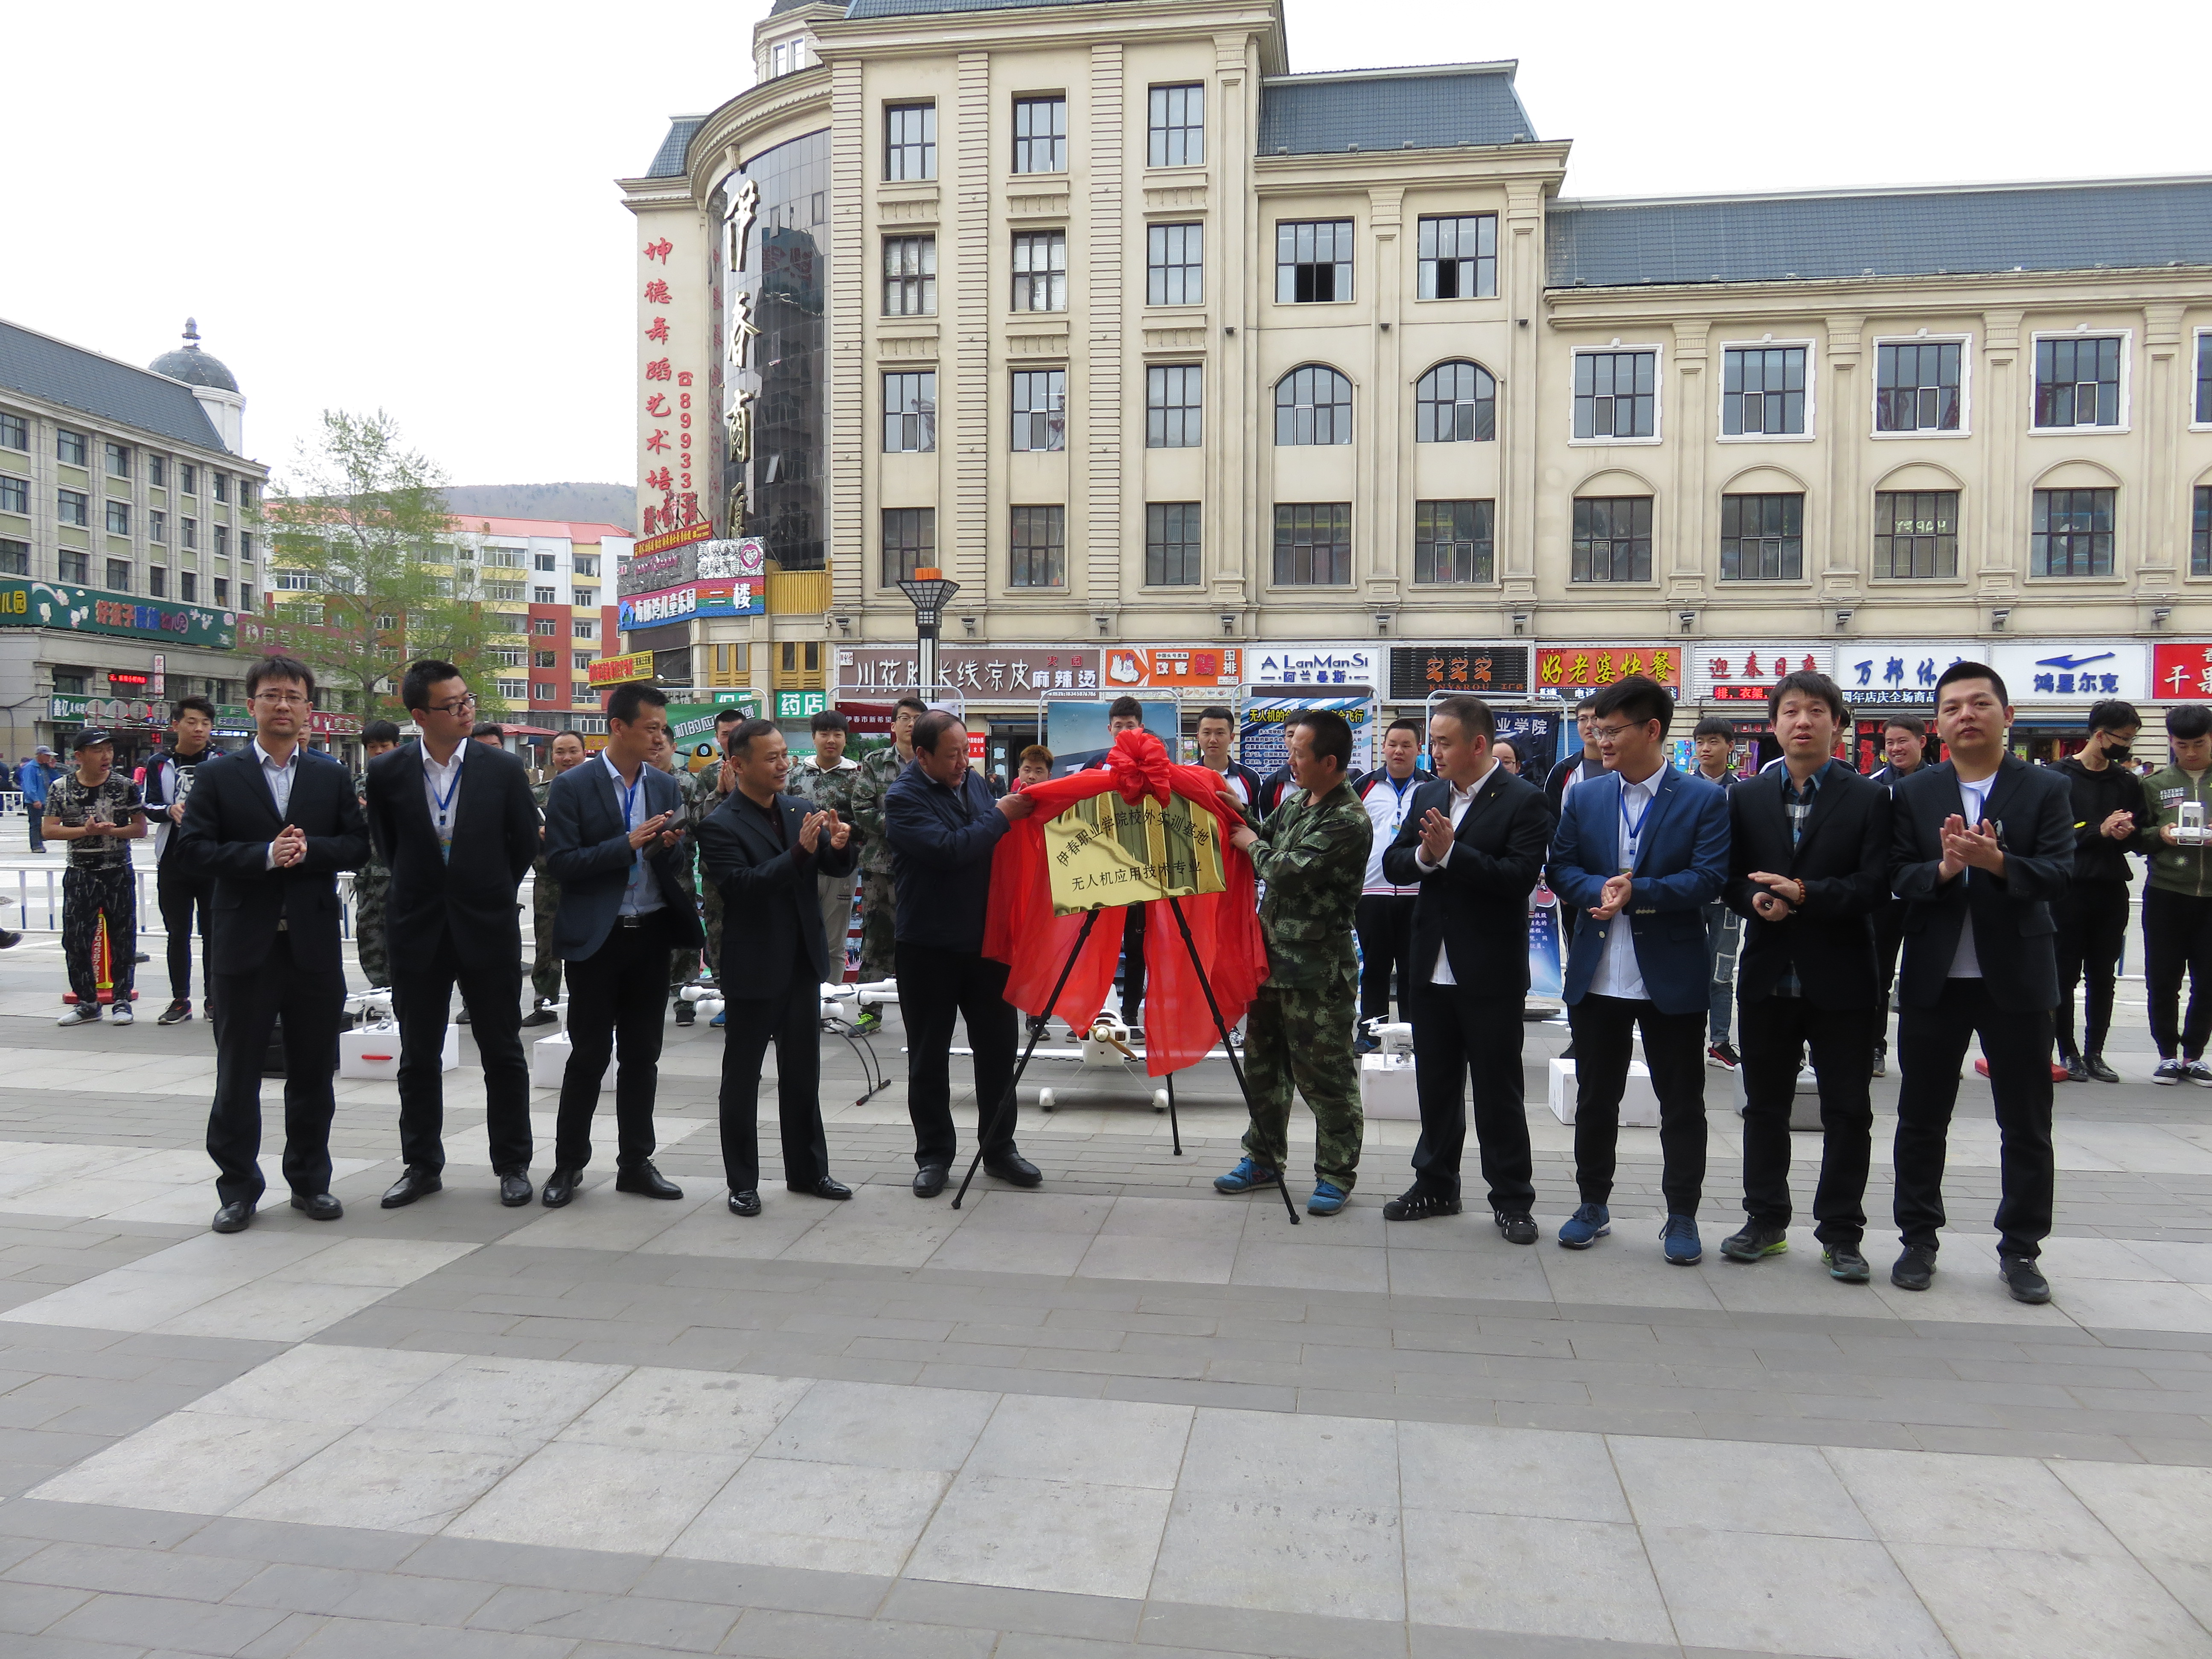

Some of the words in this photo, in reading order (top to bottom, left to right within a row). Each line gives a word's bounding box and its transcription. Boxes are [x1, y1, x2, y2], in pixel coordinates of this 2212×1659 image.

[0, 591, 27, 614] 儿园
[708, 583, 751, 609] 二楼
[1261, 655, 1278, 670] A
[1284, 653, 1368, 669] LanManSi
[1541, 651, 1676, 684] 好老婆快餐
[1032, 669, 1096, 688] 麻辣烫
[1284, 670, 1347, 683] 阿兰曼斯
[2034, 672, 2119, 693] 鸿星尔克
[781, 693, 823, 716] 药店
[1496, 717, 1548, 736] 业学院
[1056, 809, 1209, 867] 伊春职业学院校外实训基地
[1072, 859, 1202, 892] 无人机应用技术专业
